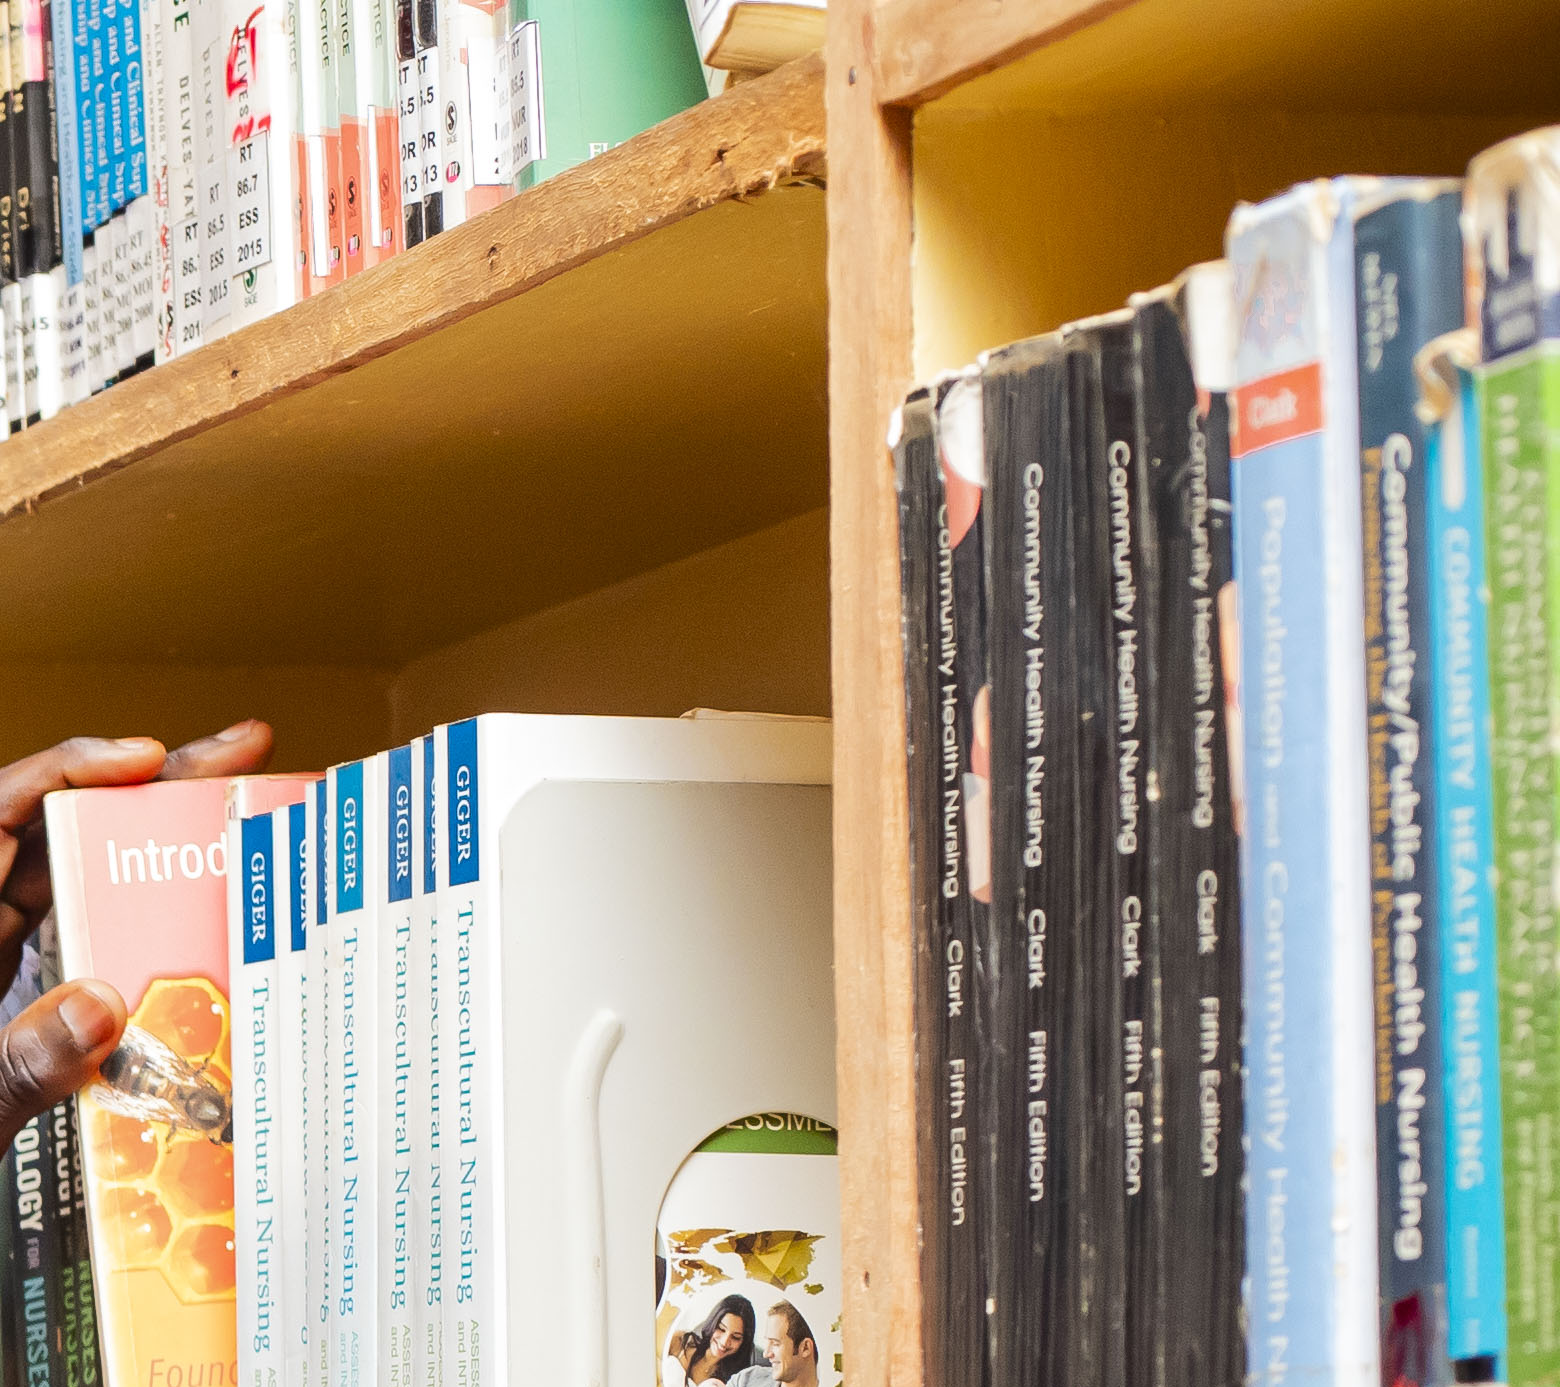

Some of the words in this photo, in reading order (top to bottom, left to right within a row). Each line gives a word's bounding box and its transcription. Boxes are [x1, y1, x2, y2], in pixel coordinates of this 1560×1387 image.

[237, 174, 258, 196] 86.7
[240, 143, 253, 163] RT
[237, 240, 263, 262] 2015
[239, 208, 259, 229] ESS
[1023, 462, 1043, 641] Community
[1108, 440, 1136, 623] Community
[1026, 648, 1044, 750] Health
[1118, 630, 1138, 733] Health
[343, 798, 356, 891] GIGER
[396, 785, 409, 881] GIGER
[456, 765, 470, 863] GIGER
[1024, 756, 1044, 868] Nursing
[1117, 740, 1139, 855] Nursing
[251, 852, 265, 944] GIGER
[1028, 909, 1046, 989] Clark
[1121, 896, 1141, 978] Clark
[1393, 892, 1425, 1056] Health
[342, 928, 359, 1164] Transcultural
[395, 917, 412, 1158] Transcultural
[456, 902, 477, 1152] Transcultural
[1028, 1031, 1047, 1092] Fifth
[1124, 1020, 1143, 1084] Fifth
[253, 979, 274, 1209] Transcultural
[1125, 1092, 1143, 1196] Edition
[1029, 1100, 1047, 1202] Edition
[1393, 1067, 1427, 1261] Nursing
[338, 1175, 359, 1317] Nursing
[390, 1167, 411, 1310] Nursing
[456, 1159, 478, 1304] Nursing
[253, 1215, 274, 1354] Nursing
